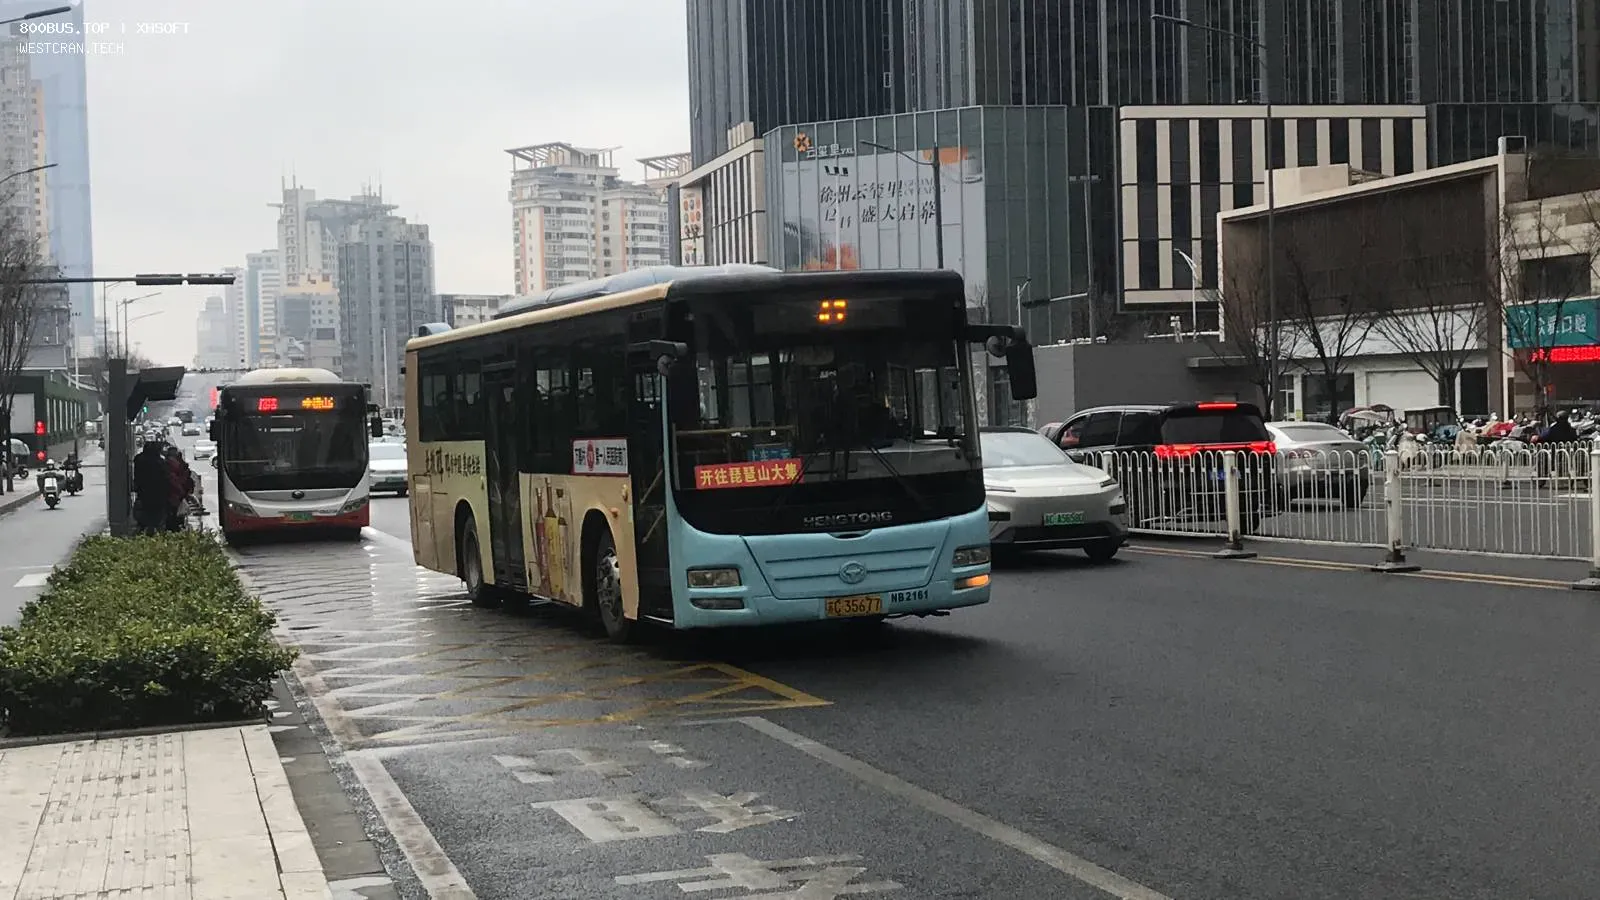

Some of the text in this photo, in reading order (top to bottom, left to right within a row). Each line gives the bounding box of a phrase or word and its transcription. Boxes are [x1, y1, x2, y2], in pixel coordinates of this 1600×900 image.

[700, 462, 798, 486] 开往琵琶山大集
[803, 511, 893, 528] HENGTONG
[890, 589, 929, 603] NB2161
